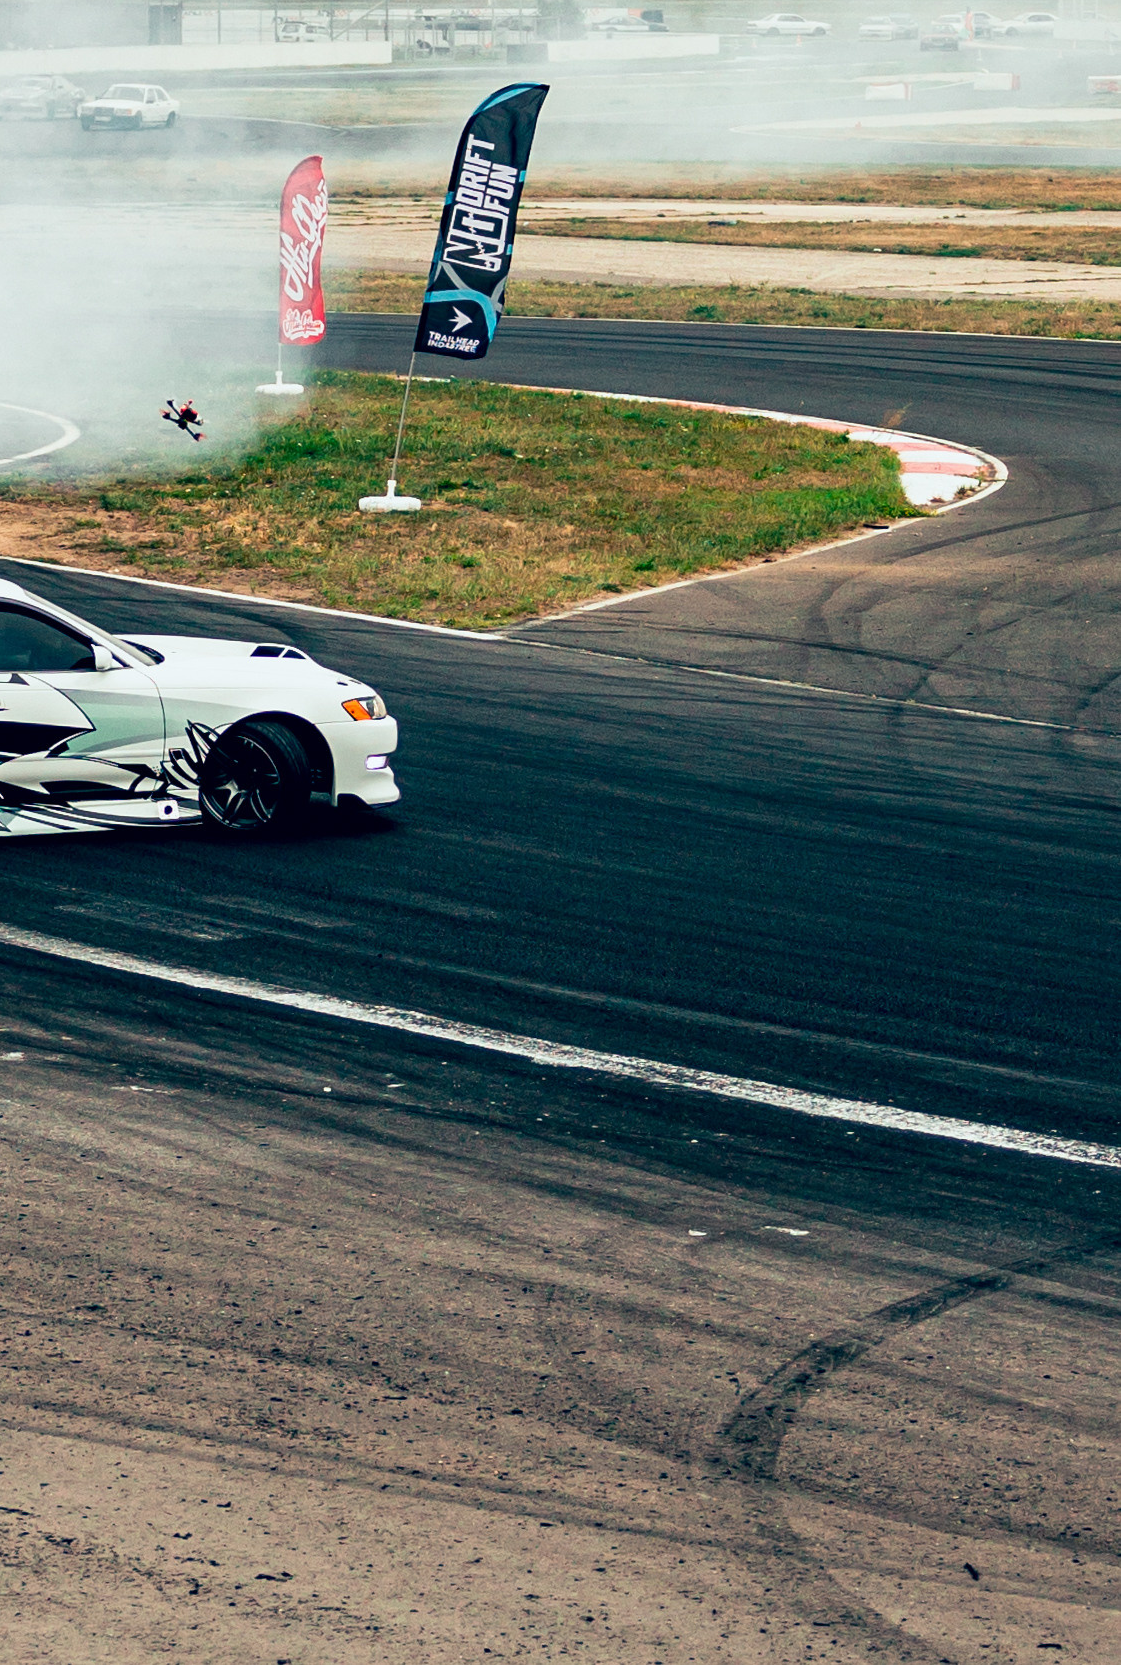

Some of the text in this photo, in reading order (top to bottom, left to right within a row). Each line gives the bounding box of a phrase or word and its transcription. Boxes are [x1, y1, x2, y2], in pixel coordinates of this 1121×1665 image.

[455, 133, 495, 208] DRIFT
[483, 163, 519, 215] FUN
[429, 330, 480, 346] TRAILHEAD
